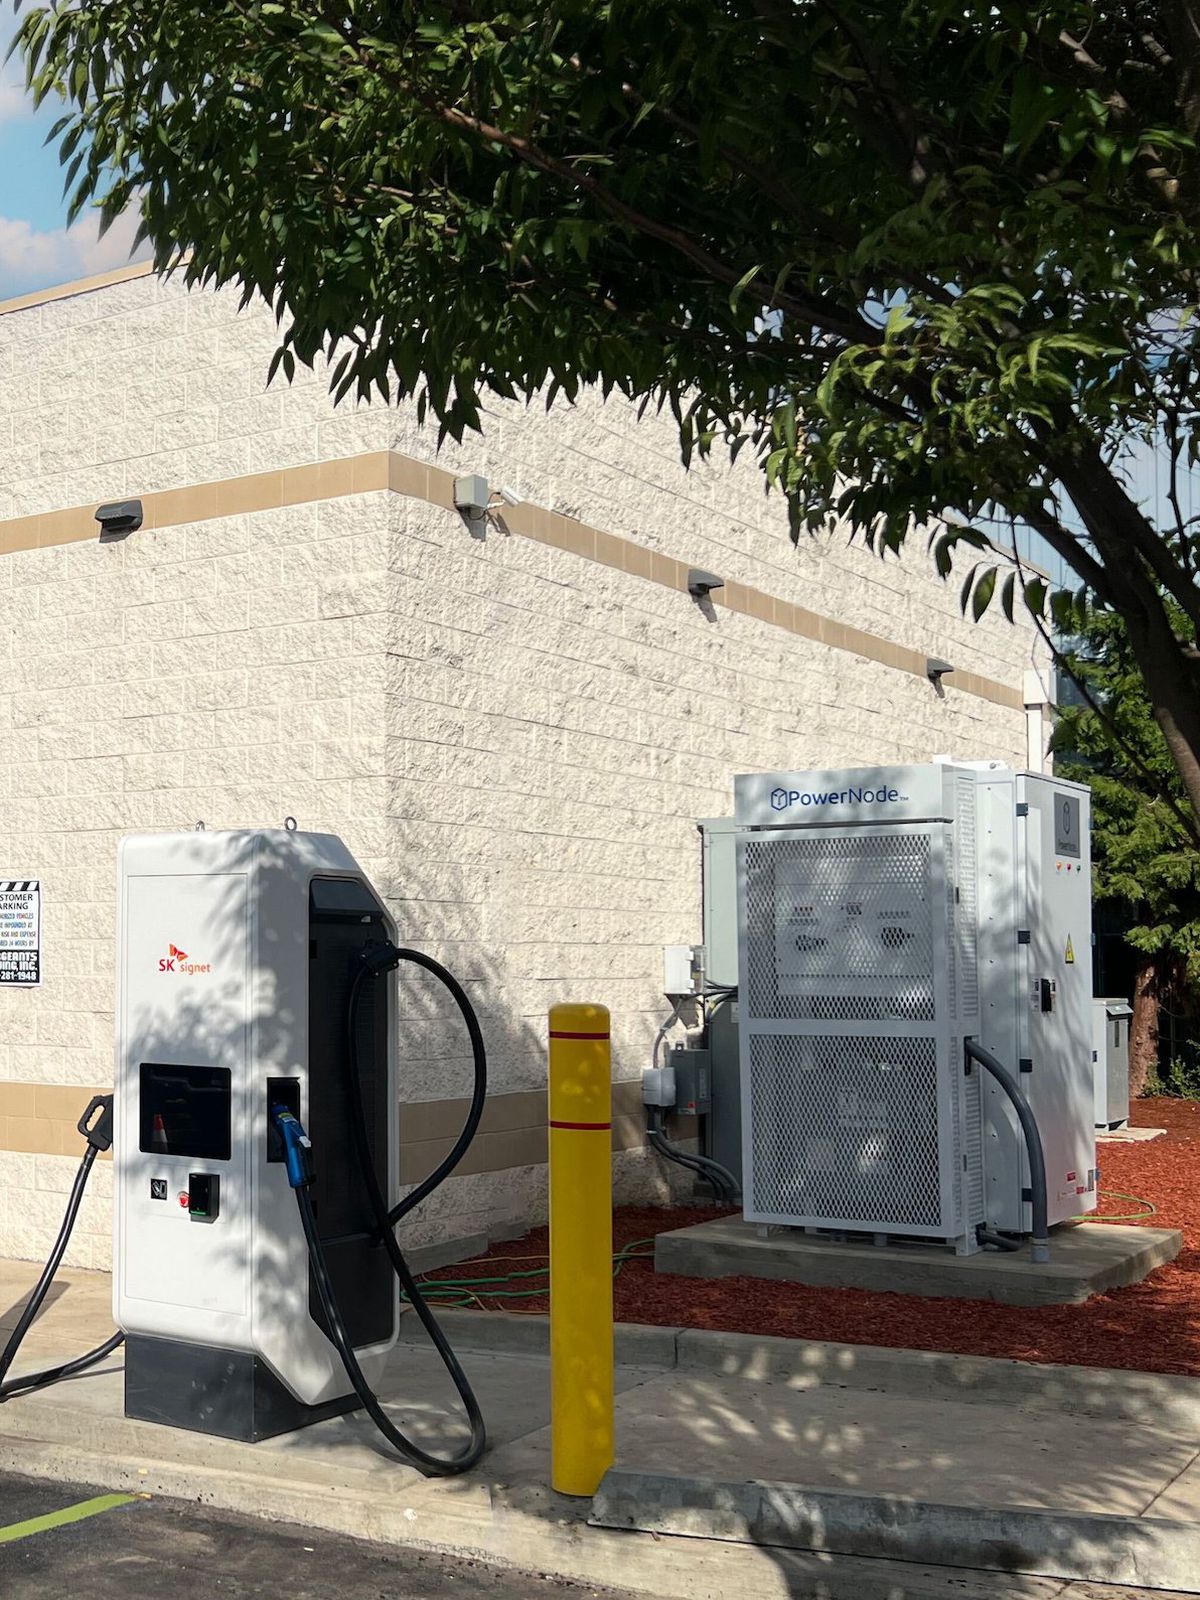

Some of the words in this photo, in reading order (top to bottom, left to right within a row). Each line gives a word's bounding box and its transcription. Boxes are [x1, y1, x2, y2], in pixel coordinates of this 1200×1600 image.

[788, 785, 899, 807] PowerNode
[19, 961, 38, 971] INC.
[158, 958, 175, 972] SK
[179, 962, 211, 976] signet
